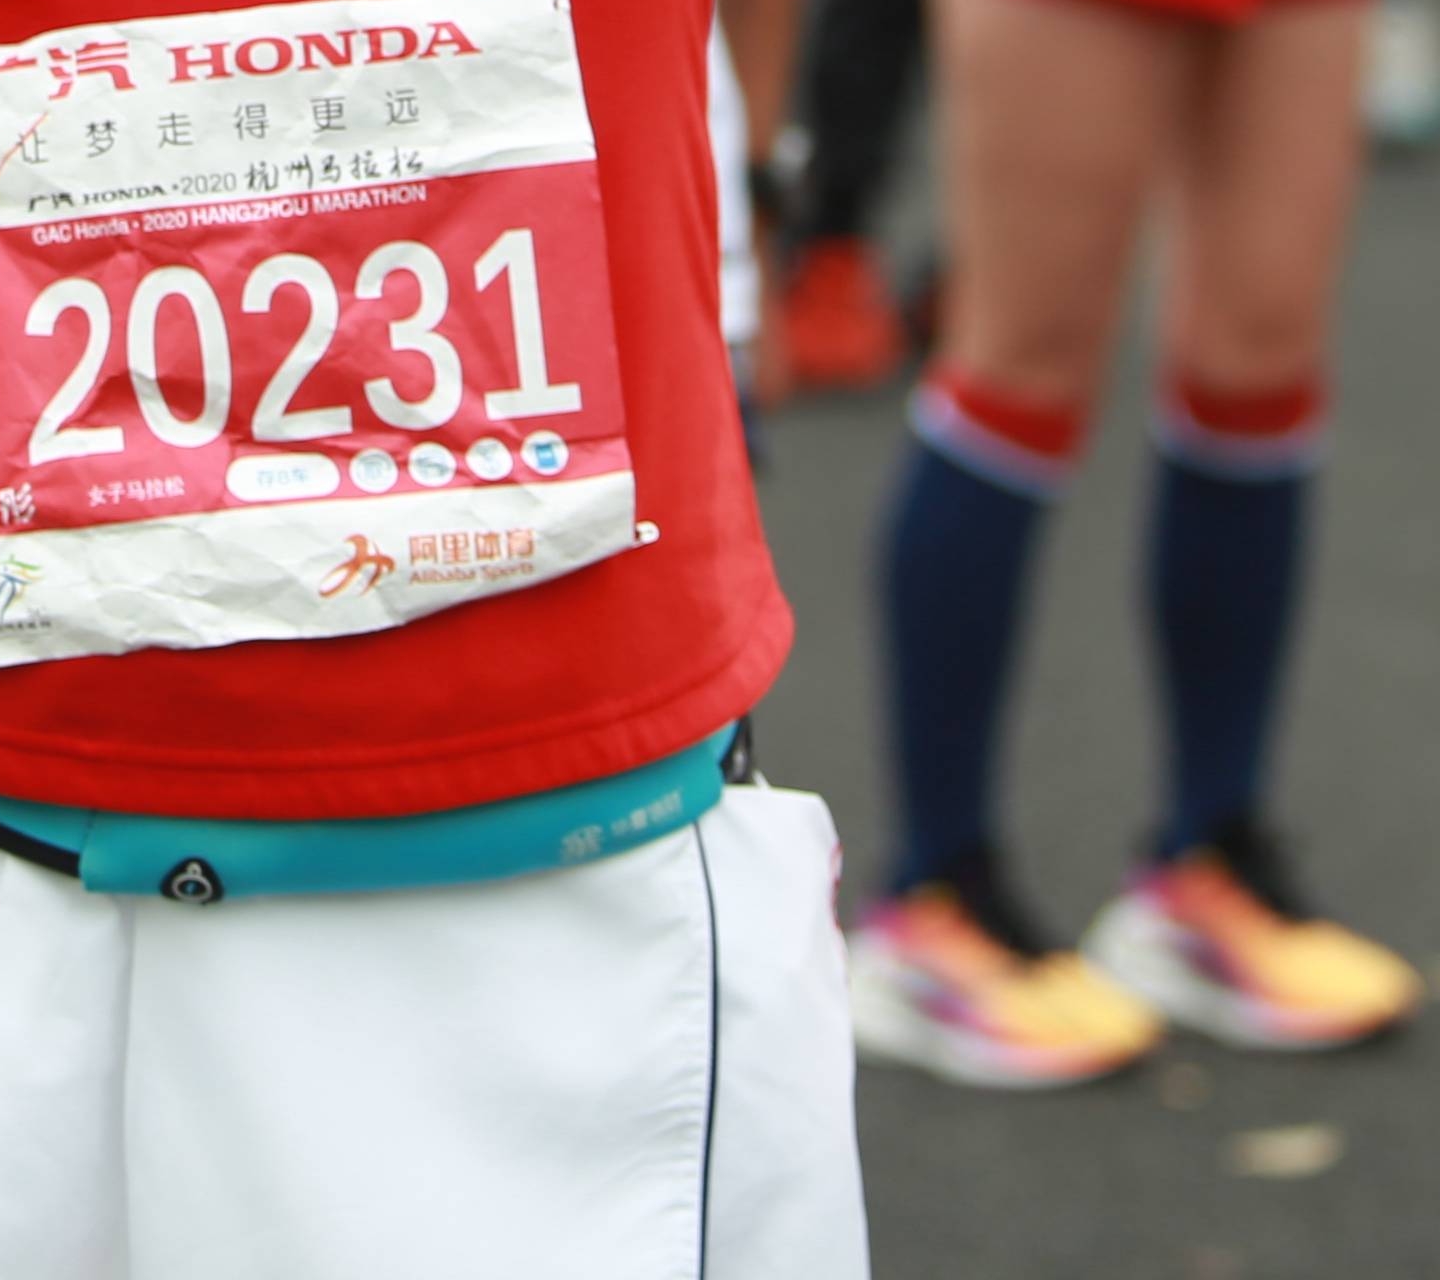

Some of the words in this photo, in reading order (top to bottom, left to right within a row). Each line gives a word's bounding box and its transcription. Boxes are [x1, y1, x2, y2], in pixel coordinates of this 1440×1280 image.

[169, 22, 480, 83] HONDA
[17, 89, 421, 164] 让梦走得更远
[84, 185, 165, 206] HONDA
[245, 146, 423, 191] 杭州马拉松
[33, 224, 72, 246] GAC
[75, 218, 129, 240] Honda
[143, 211, 188, 233] 2020
[191, 198, 308, 227] HANGZHOU
[314, 186, 427, 214] MARATHON
[25, 229, 581, 465] 20231
